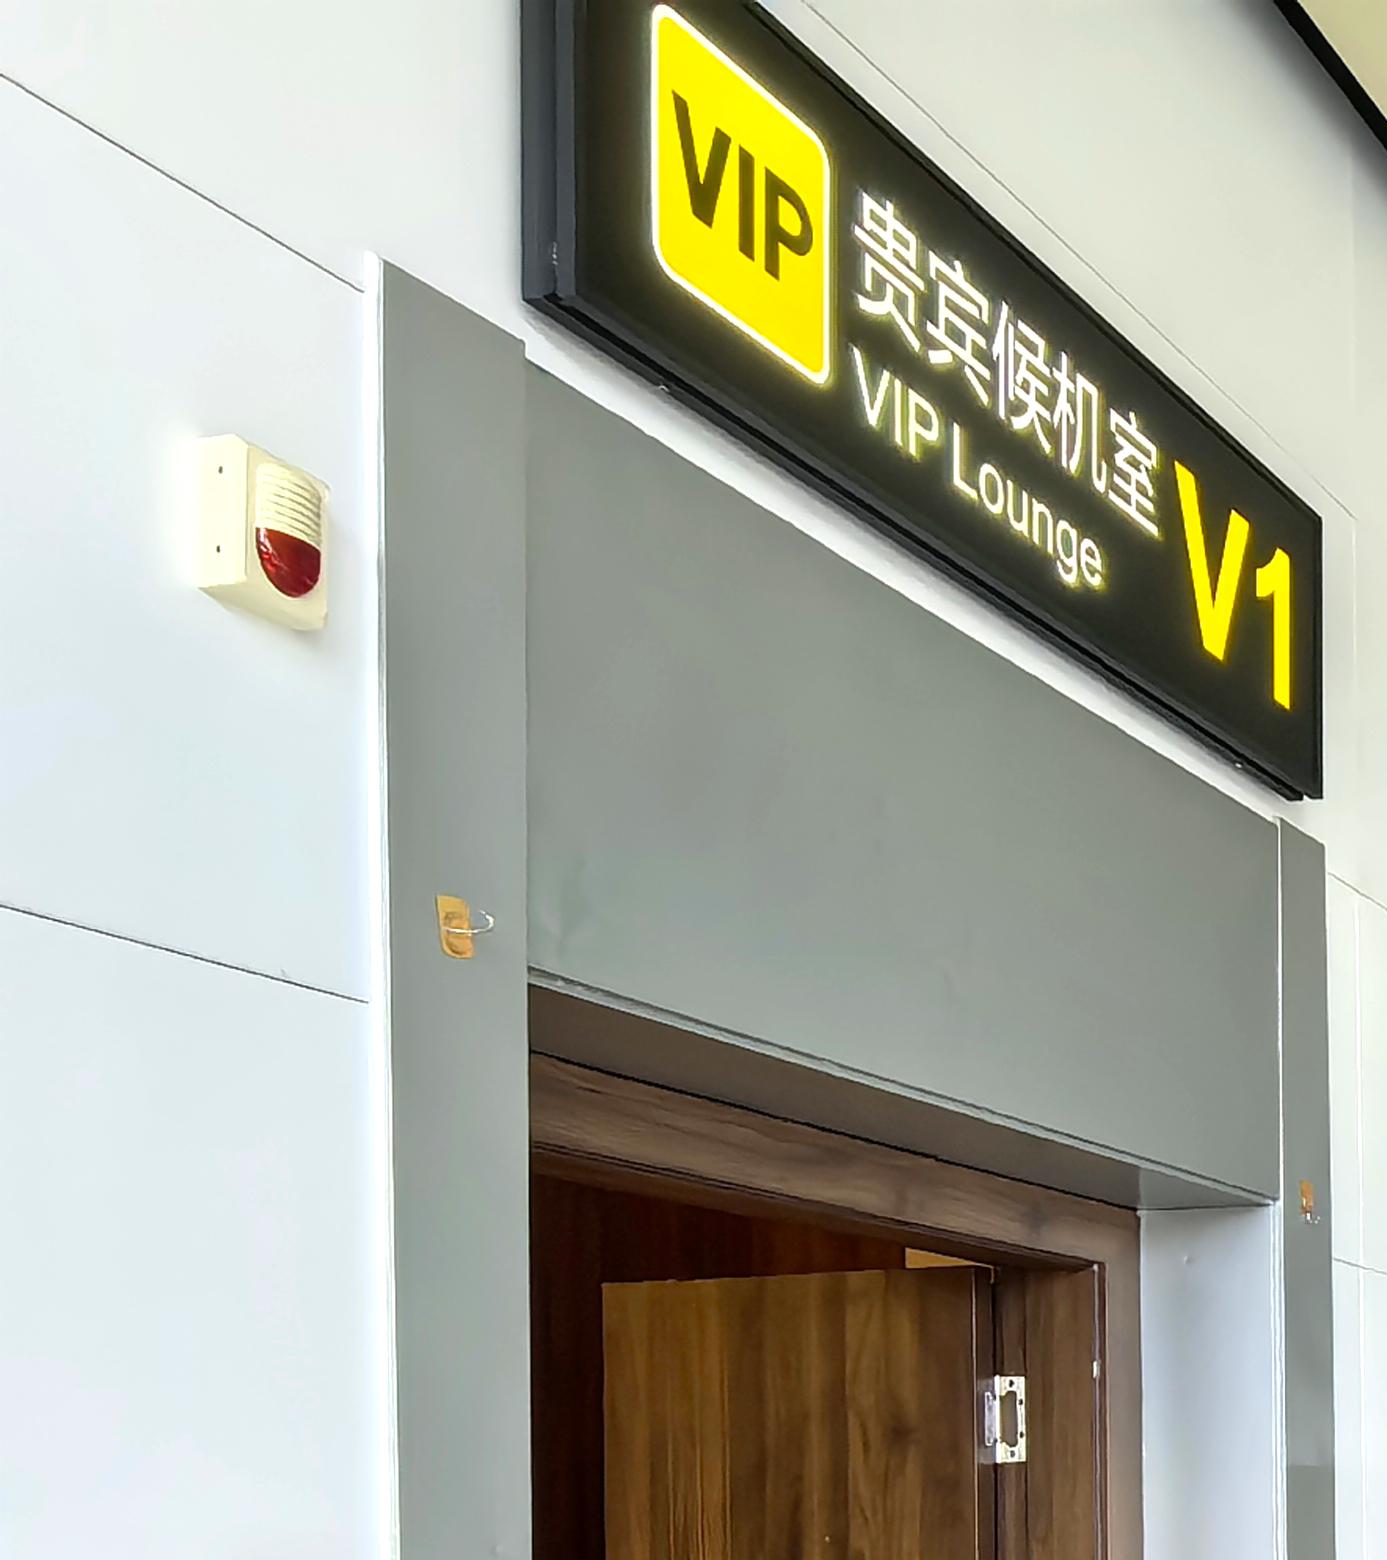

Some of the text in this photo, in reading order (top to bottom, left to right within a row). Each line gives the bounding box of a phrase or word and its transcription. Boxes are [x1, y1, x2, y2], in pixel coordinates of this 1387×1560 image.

[672, 89, 814, 281] VIP
[849, 343, 1106, 588] VIP Lounge
[853, 186, 1161, 539] 贵宾候机室
[1174, 460, 1293, 711] V1
